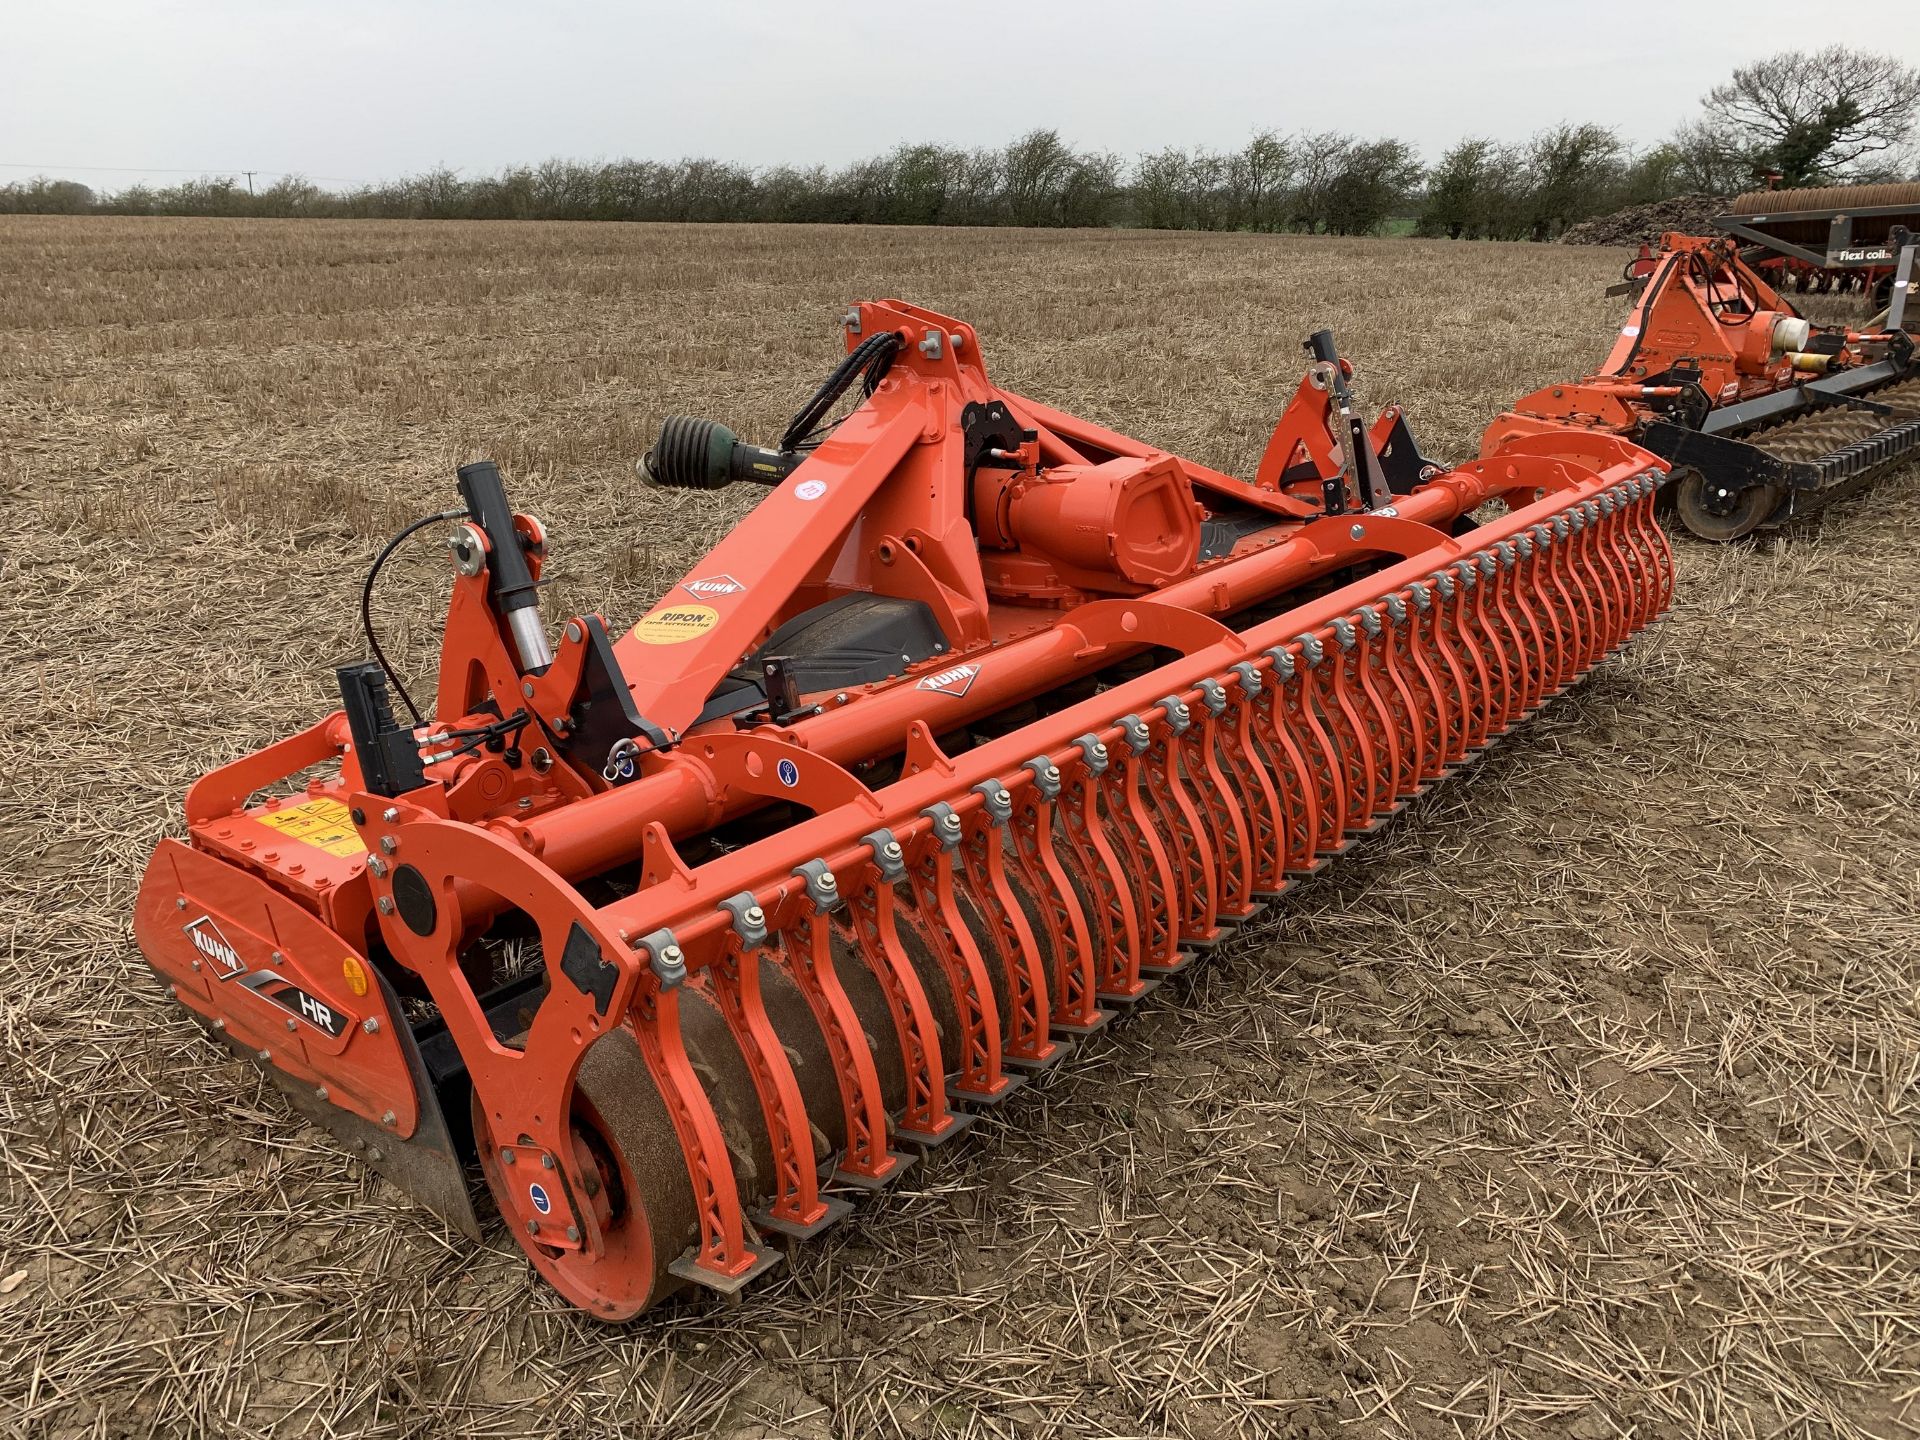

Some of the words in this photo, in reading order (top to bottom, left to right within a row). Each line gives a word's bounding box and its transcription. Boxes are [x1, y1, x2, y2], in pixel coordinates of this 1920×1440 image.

[1840, 250, 1865, 261] flexi
[1866, 249, 1885, 260] coil
[690, 581, 737, 593] KUHN
[660, 613, 706, 622] RIPON
[924, 665, 975, 689] KUHN
[192, 927, 239, 972] KUHN
[299, 991, 336, 1034] HR
